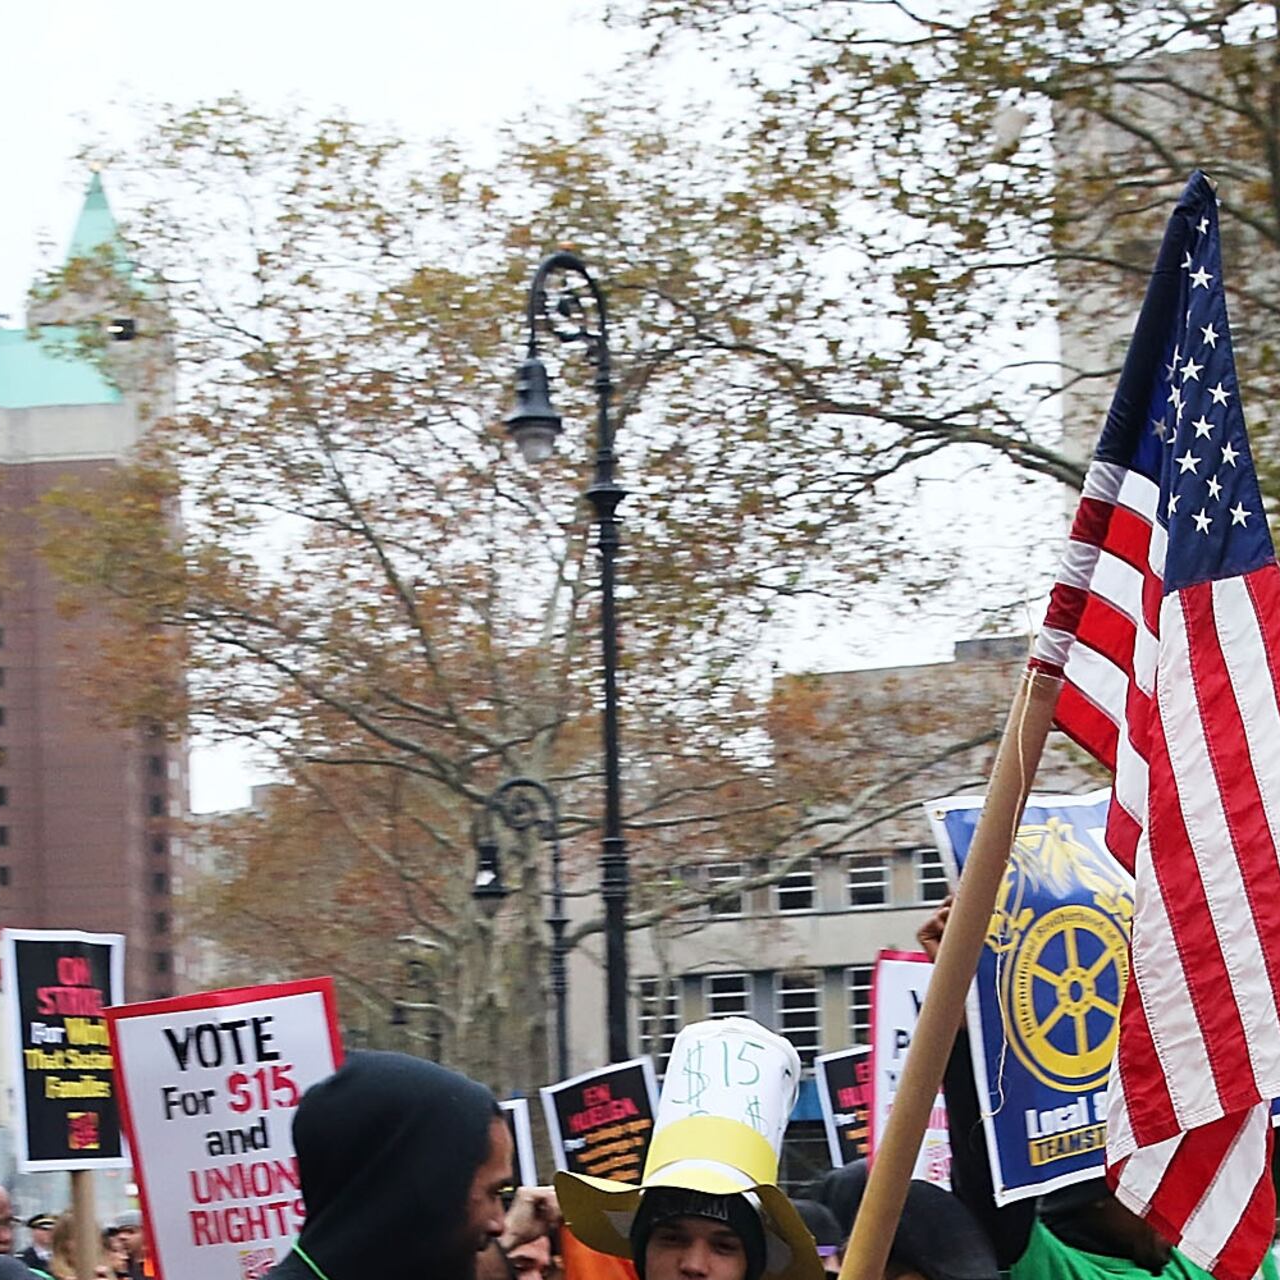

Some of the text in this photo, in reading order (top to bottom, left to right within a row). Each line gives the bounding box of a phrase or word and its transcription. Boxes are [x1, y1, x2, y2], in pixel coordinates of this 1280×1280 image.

[57, 957, 91, 986] ON
[36, 986, 104, 1016] STRIKE
[30, 1022, 65, 1044] For
[162, 1016, 281, 1071] VOTE
[45, 1075, 111, 1098] Families
[161, 1064, 303, 1120] For $15
[206, 1117, 271, 1157] and
[1025, 1096, 1088, 1139] Local
[1035, 1124, 1107, 1159] TEAMST
[189, 1156, 303, 1206] UNION
[189, 1199, 306, 1247] RIGHTS
